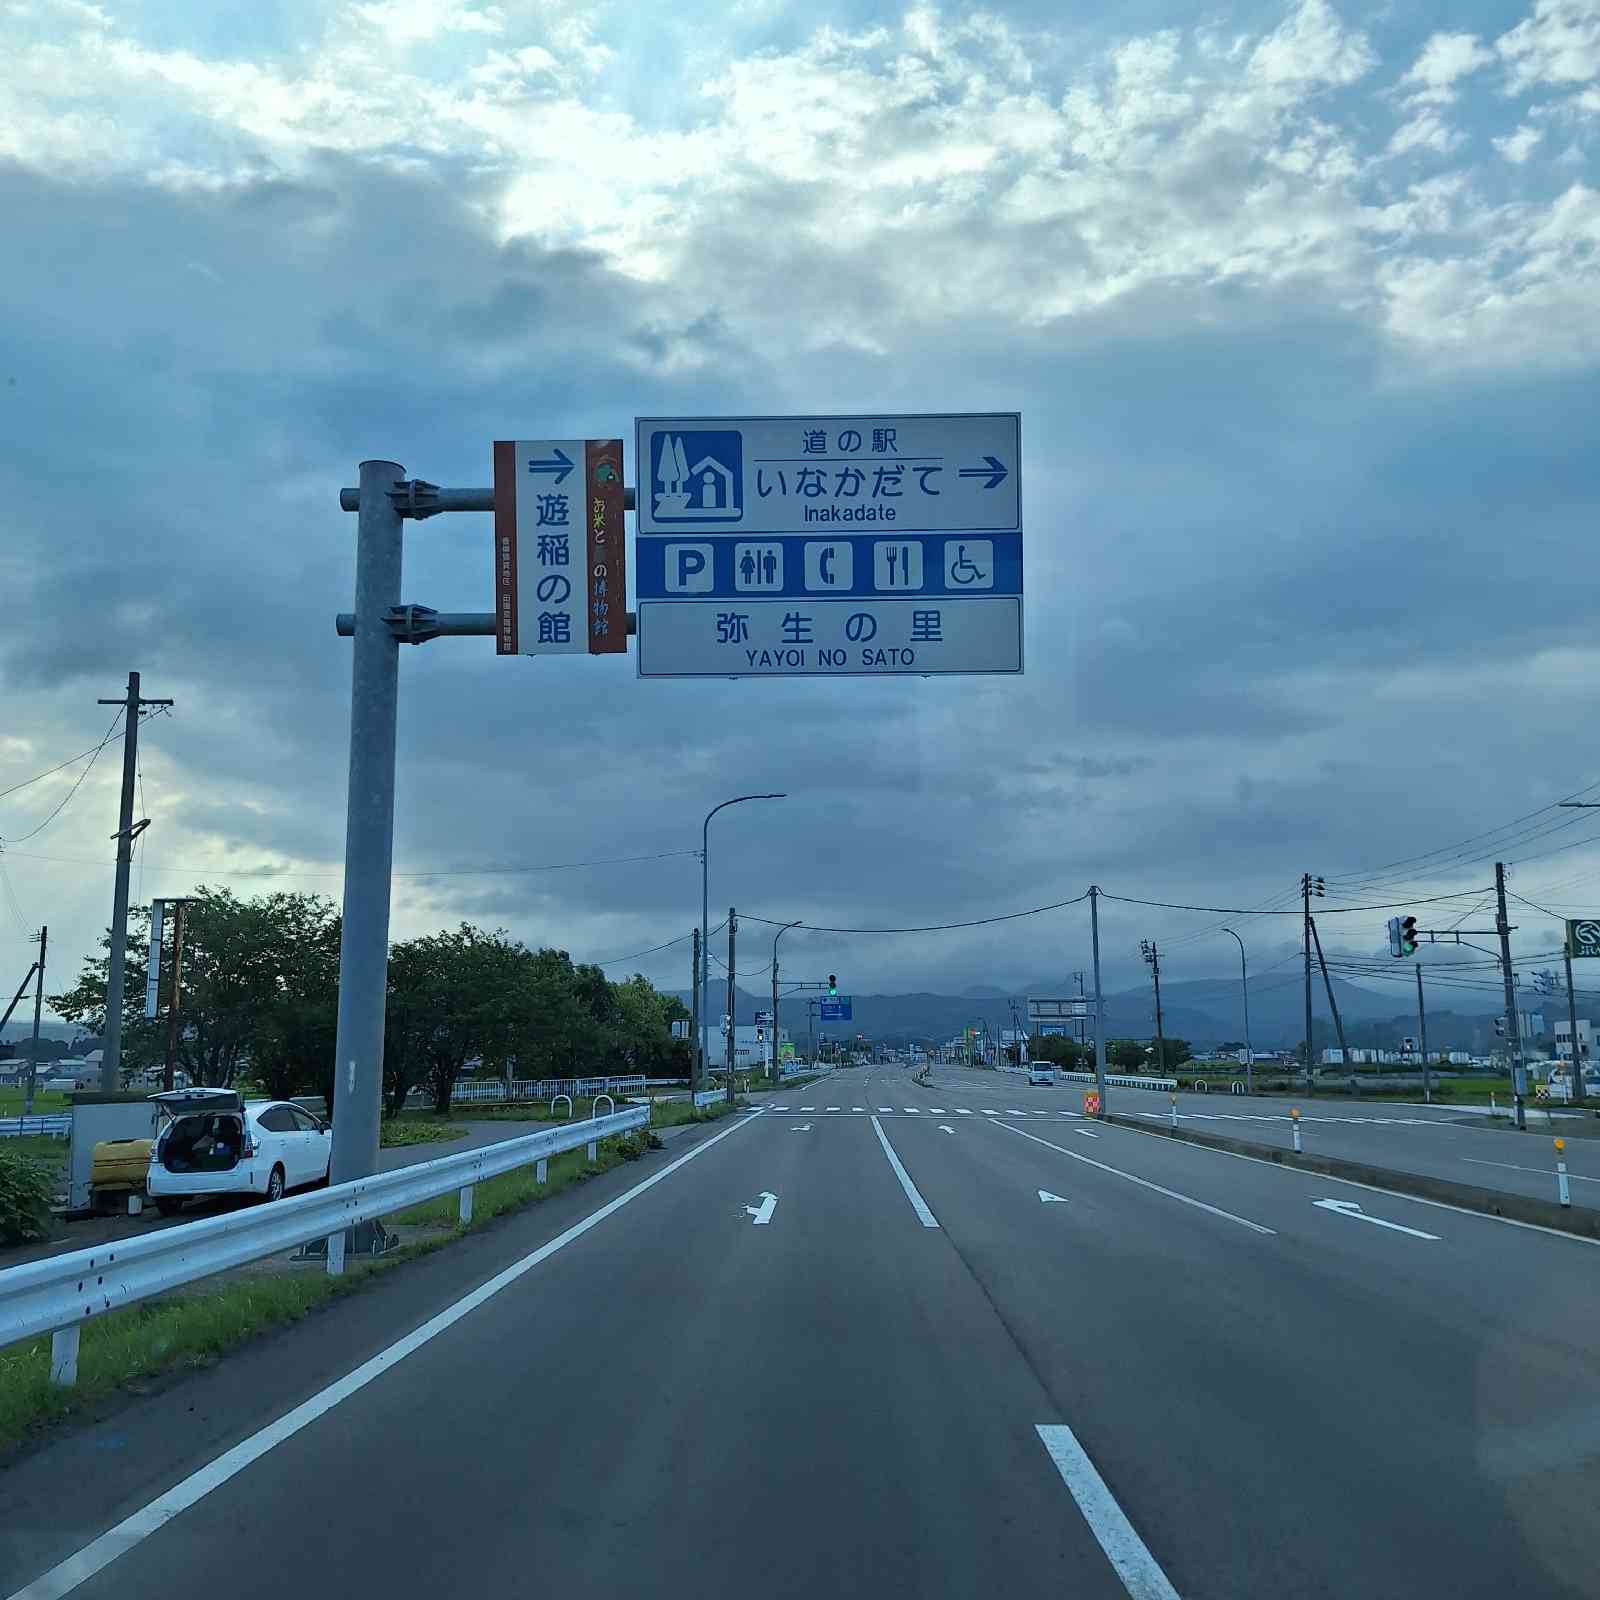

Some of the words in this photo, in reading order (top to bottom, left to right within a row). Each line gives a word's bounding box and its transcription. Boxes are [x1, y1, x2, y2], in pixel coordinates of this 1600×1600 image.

[803, 428, 898, 454] 道の駅
[757, 465, 943, 498] いなかだて
[804, 504, 896, 522] Inakadate
[536, 494, 571, 644] 遊稲の館
[678, 550, 706, 586] P
[717, 610, 943, 643] 弥生の里
[746, 650, 804, 666] YAYOI
[818, 649, 847, 666] NO
[862, 648, 915, 666] SATO
